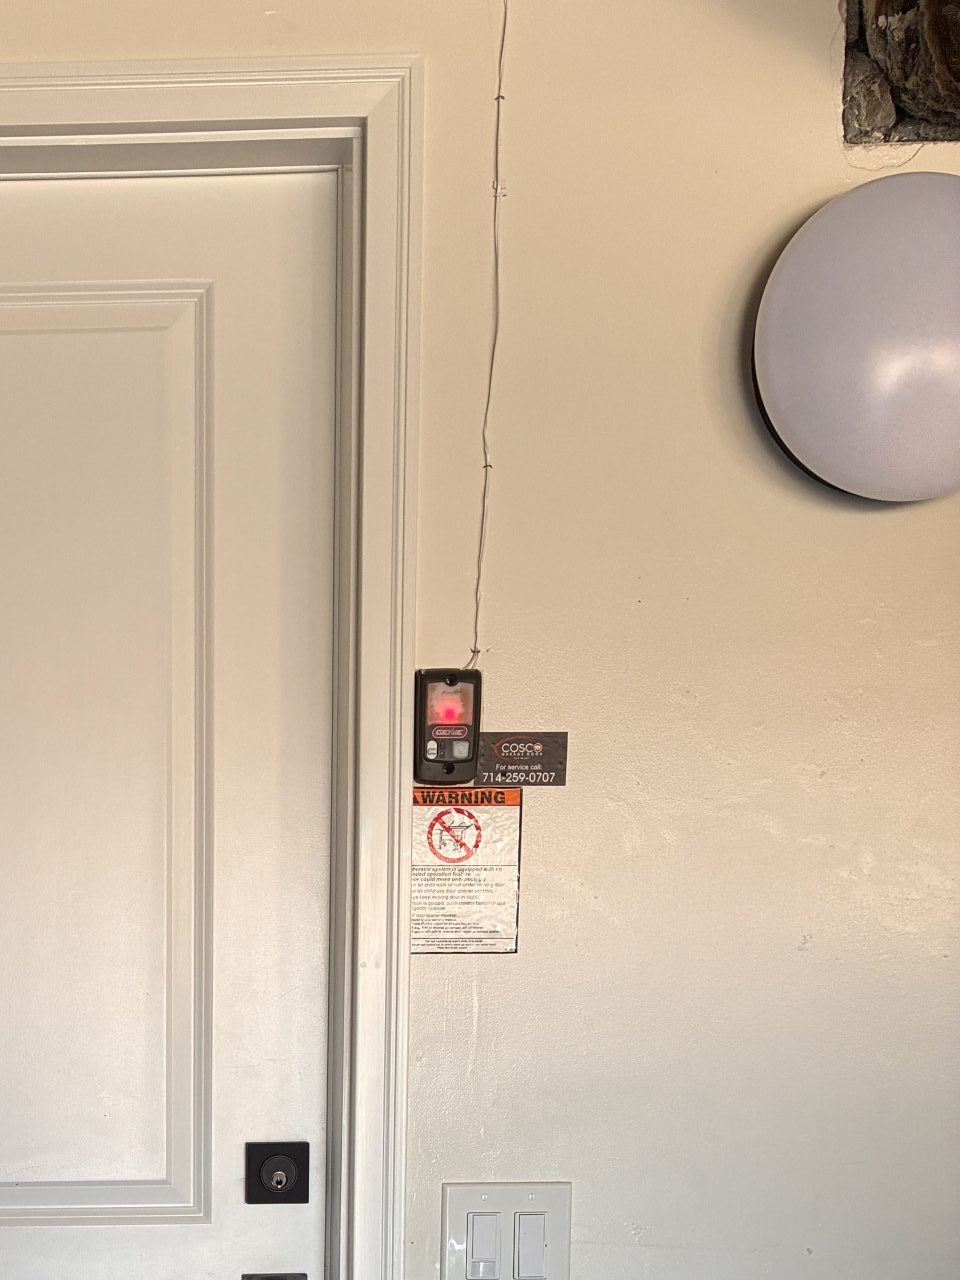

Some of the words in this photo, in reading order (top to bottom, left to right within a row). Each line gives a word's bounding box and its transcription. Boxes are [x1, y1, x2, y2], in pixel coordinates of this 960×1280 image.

[435, 728, 465, 736] GENIE
[496, 763, 507, 771] For
[507, 763, 529, 771] service
[530, 763, 543, 771] call:
[482, 772, 556, 783] 714-259-0707
[420, 790, 506, 804] WARNING
